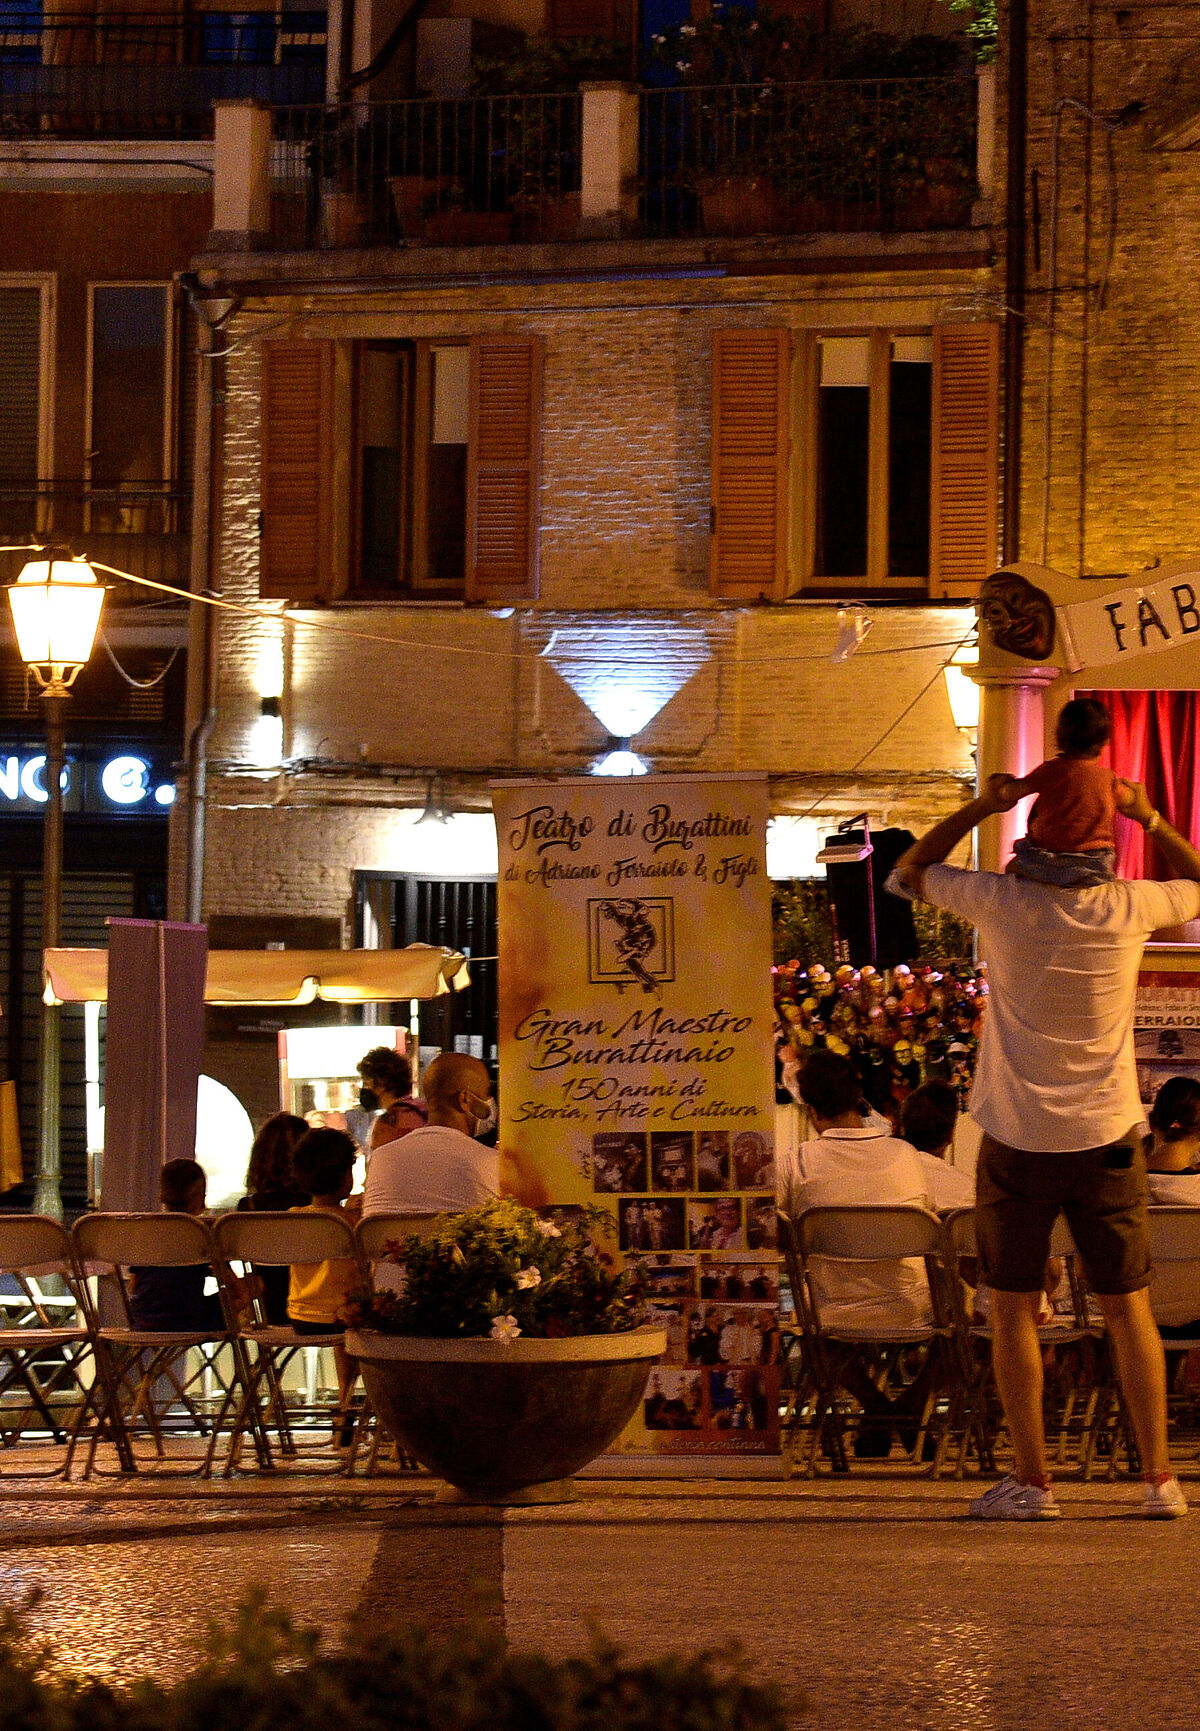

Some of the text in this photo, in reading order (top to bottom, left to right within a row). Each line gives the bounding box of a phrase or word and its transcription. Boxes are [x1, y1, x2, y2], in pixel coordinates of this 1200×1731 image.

[510, 804, 754, 855] Teatro di Burattini
[504, 863, 520, 881] di
[525, 858, 601, 888] Adriano
[713, 854, 760, 888] Figli
[514, 1007, 753, 1046] Gran Maestro
[529, 1037, 735, 1071] Burattinaio
[562, 1077, 708, 1101] 150 anni di
[511, 1099, 763, 1123] Storia, Arte e Cultura
